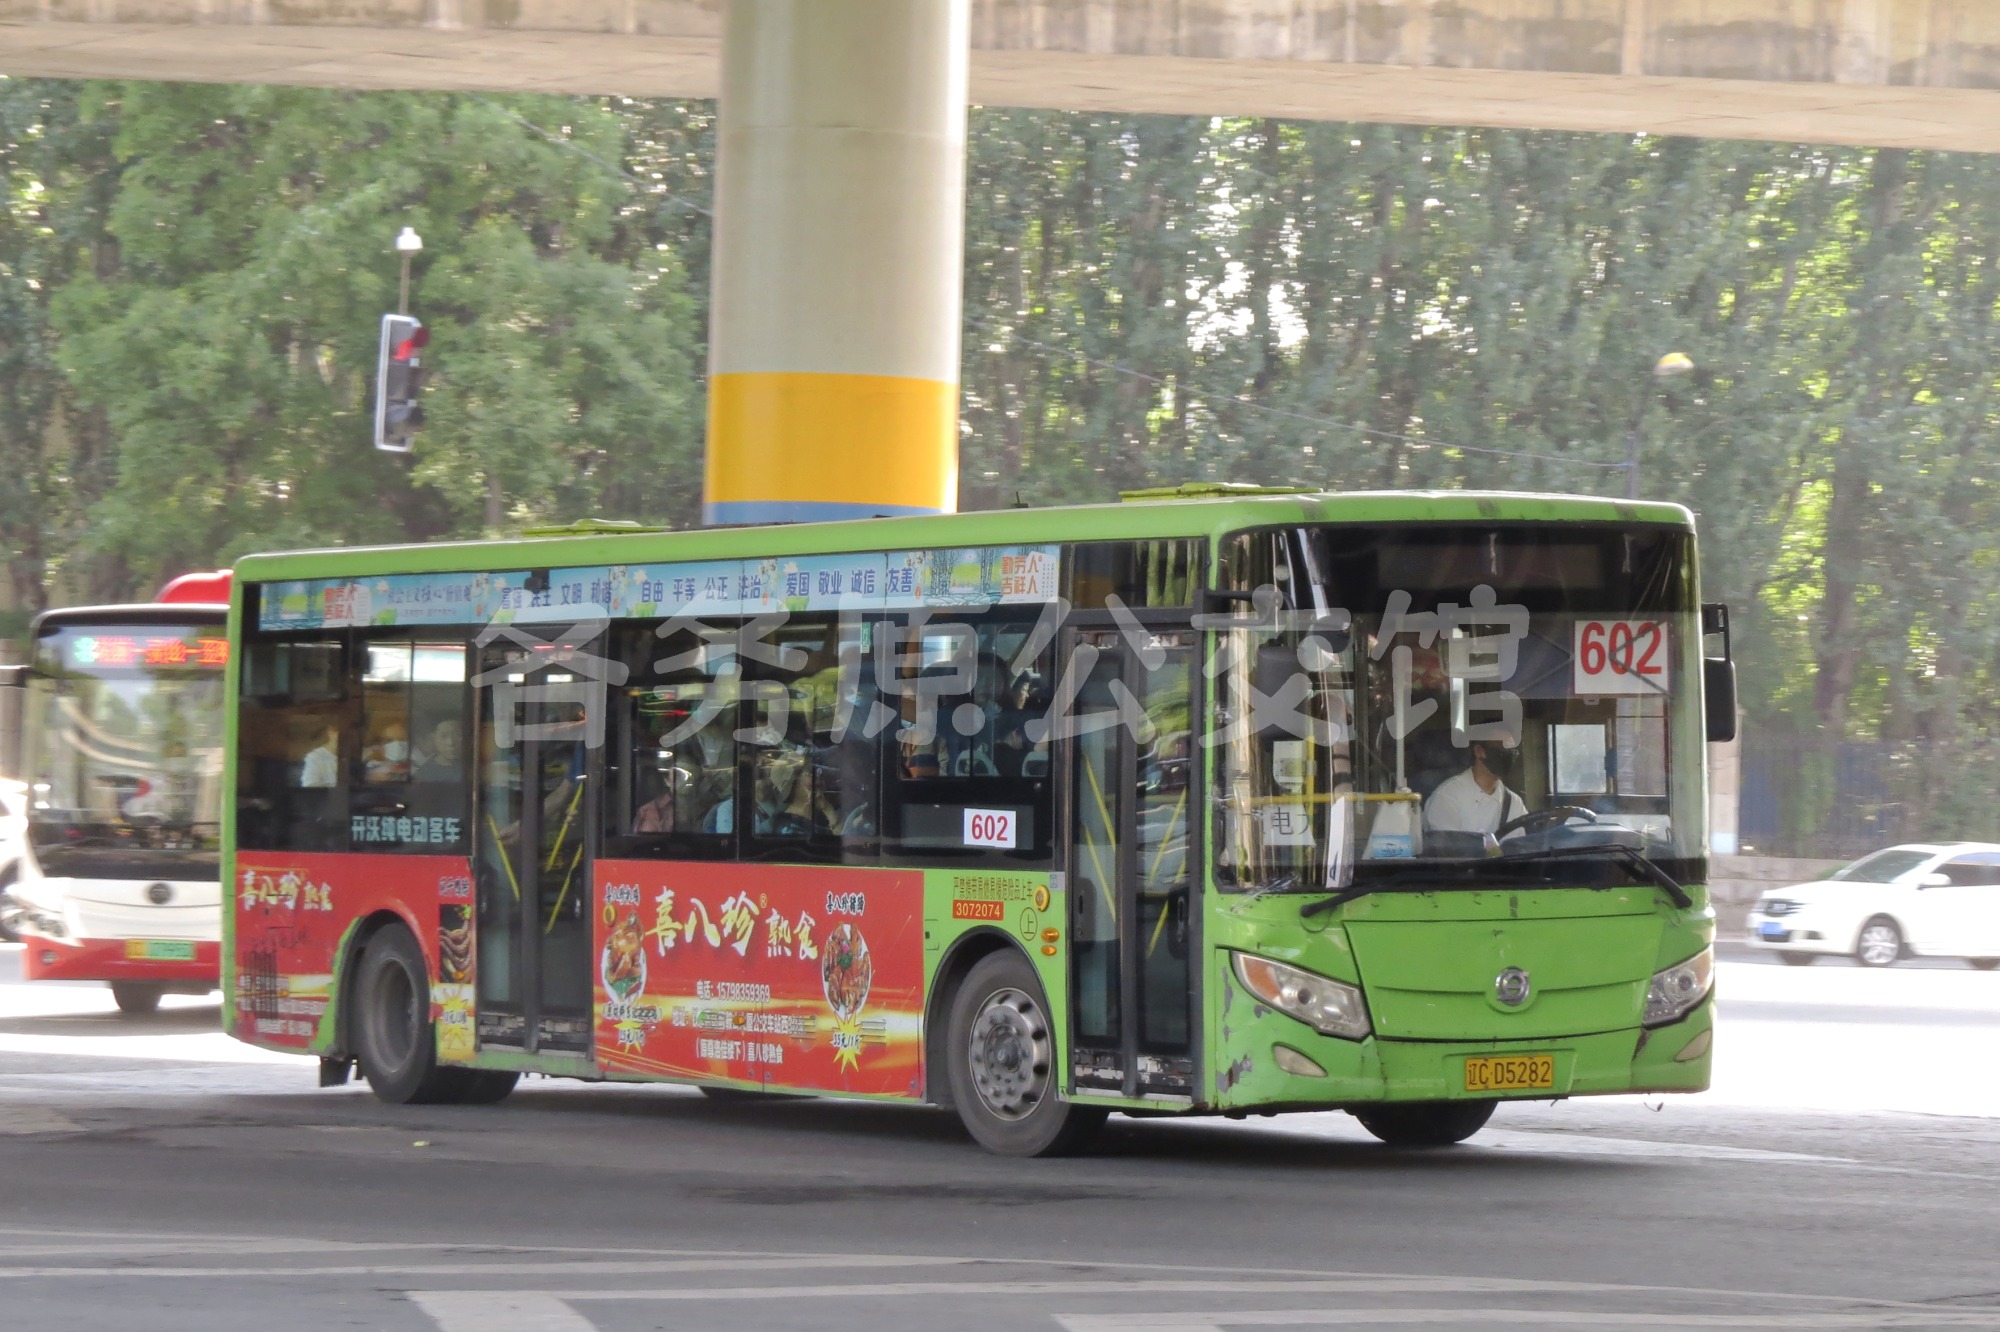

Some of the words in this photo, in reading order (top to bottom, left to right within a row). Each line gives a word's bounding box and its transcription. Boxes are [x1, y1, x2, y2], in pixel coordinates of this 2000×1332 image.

[1002, 555, 1039, 574] 勤劳人
[560, 581, 582, 605] 文明
[592, 578, 612, 604] 和谐
[641, 579, 663, 602] 自由
[673, 578, 696, 601] 平等
[705, 576, 728, 600] 公正
[738, 575, 761, 599] 法治
[786, 571, 810, 596] 爱国
[818, 570, 842, 595] 敬业
[851, 568, 876, 594] 诚信
[886, 567, 913, 593] 友善
[1002, 575, 1038, 595] 吉祥人
[1580, 622, 1662, 675] 602
[351, 815, 461, 843] 开沃纯电动客车
[971, 814, 1008, 841] 602
[956, 902, 1001, 918] 3072074
